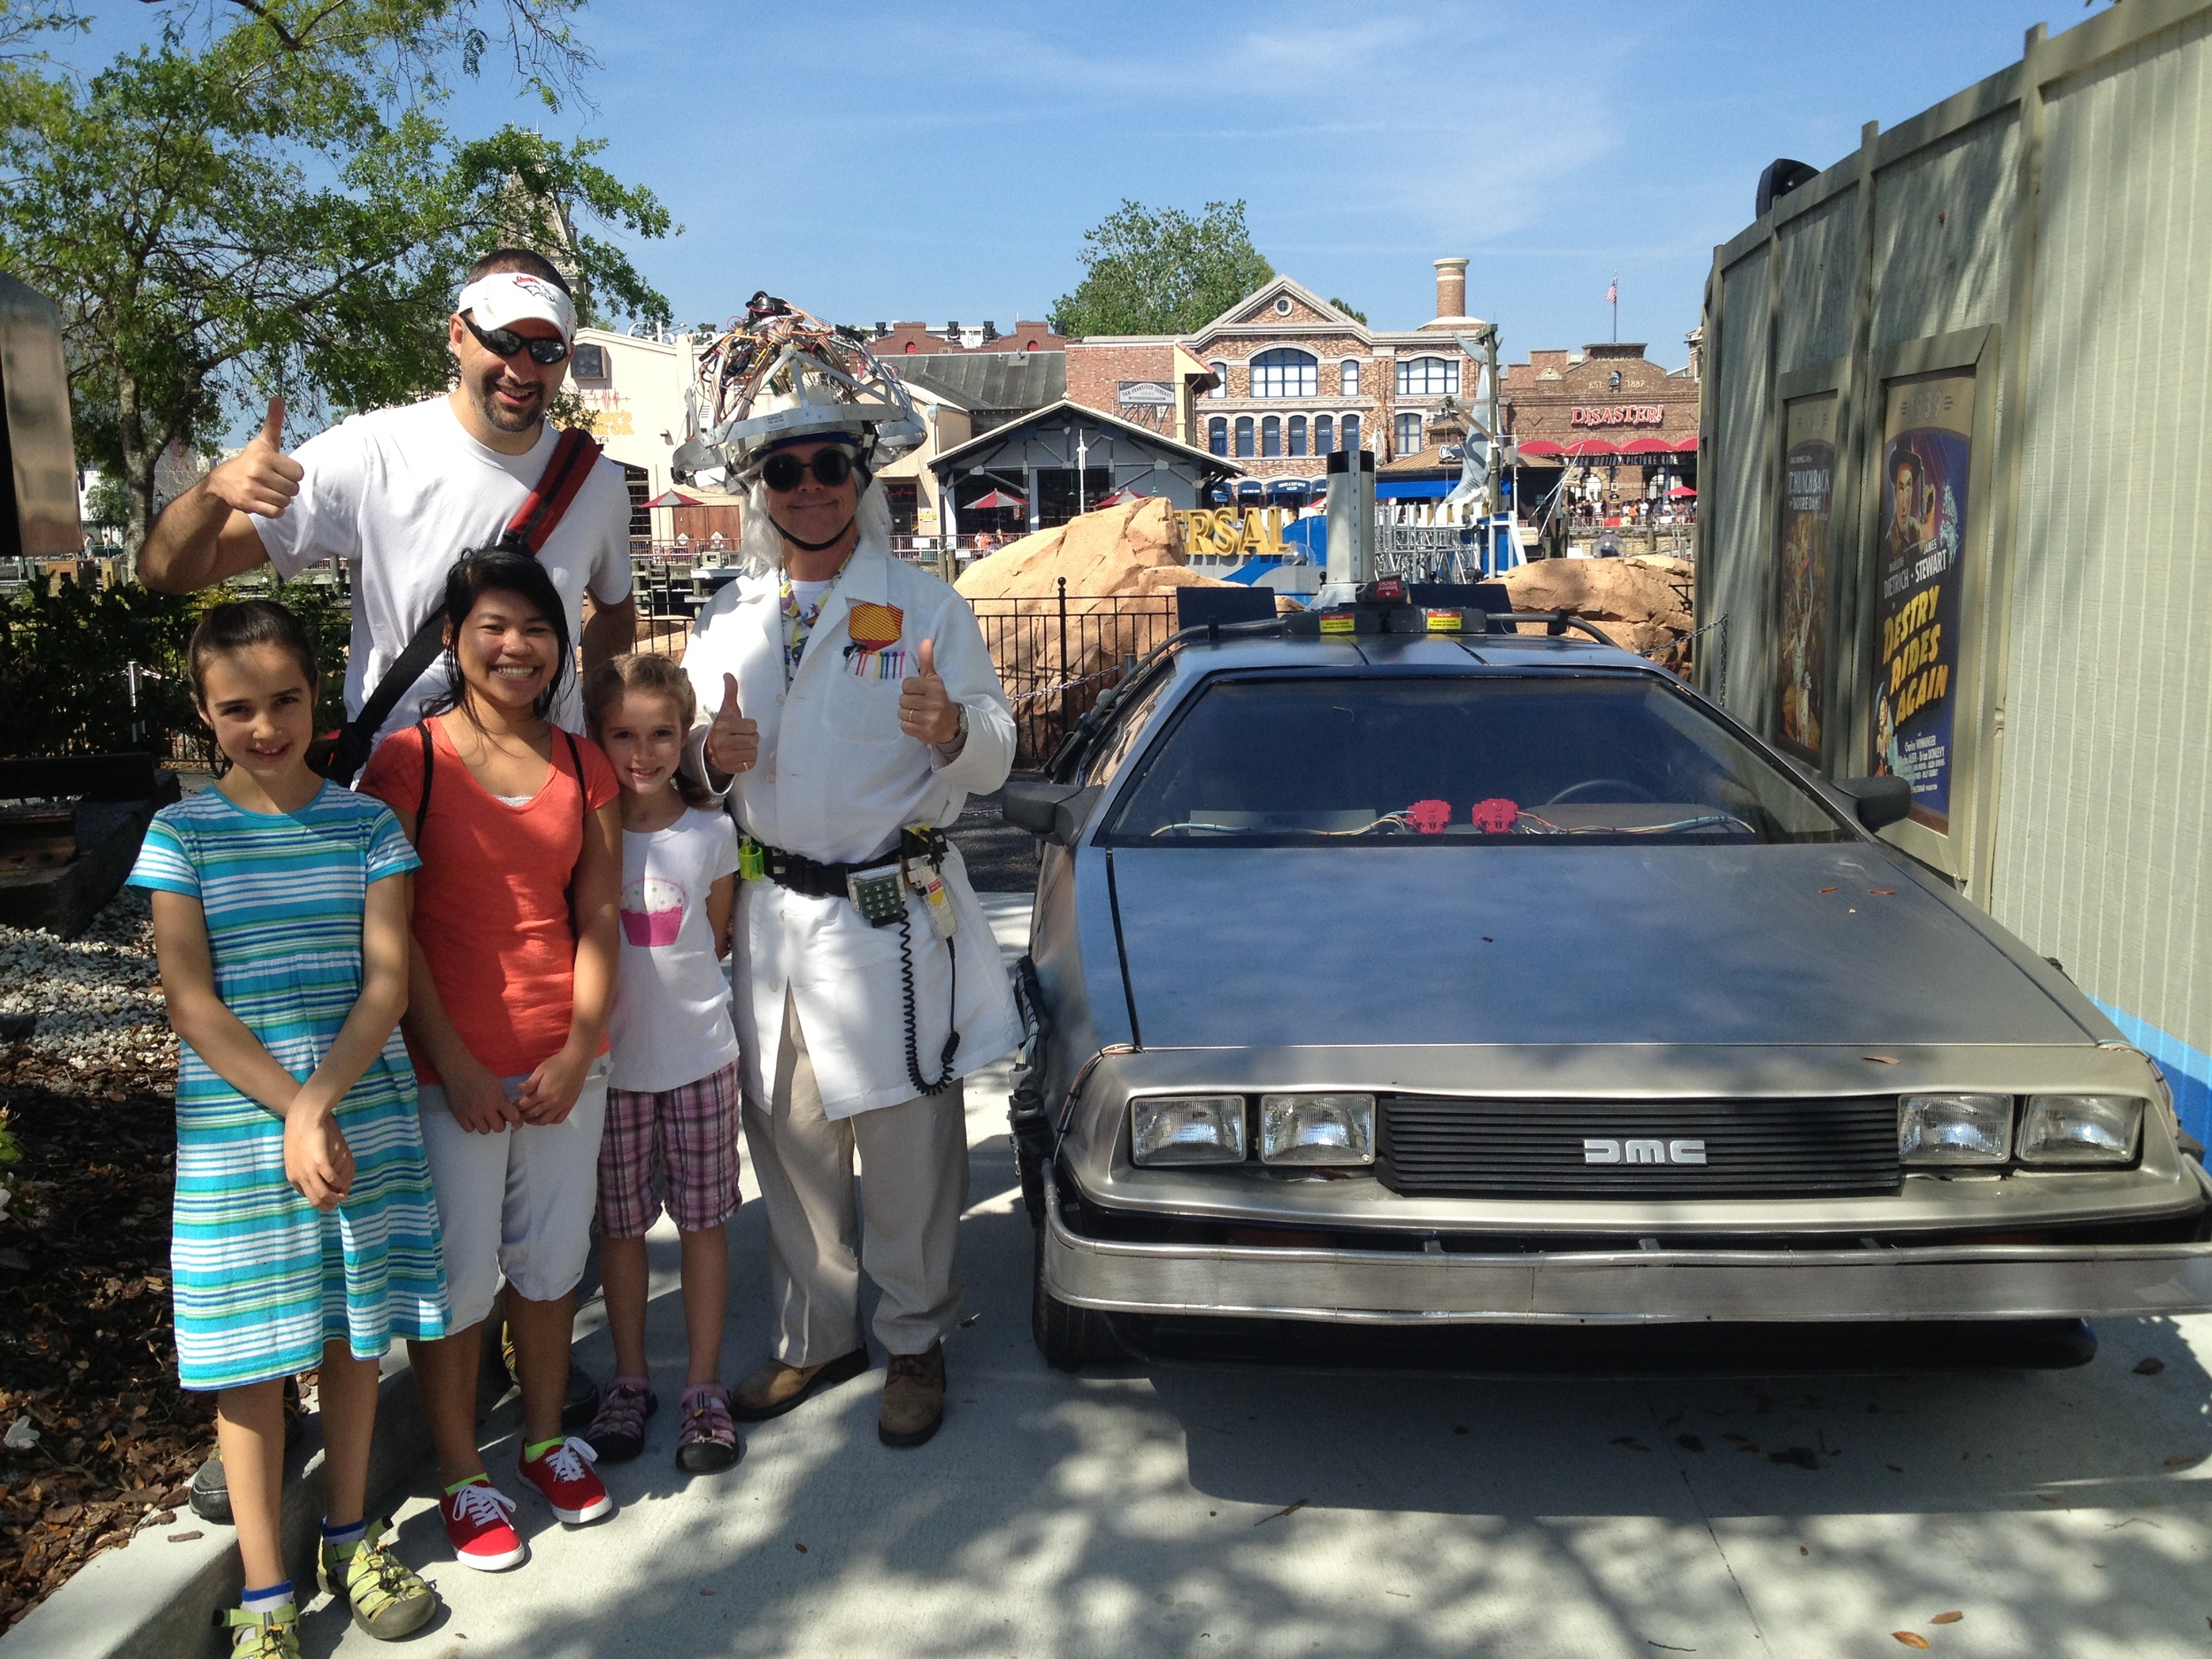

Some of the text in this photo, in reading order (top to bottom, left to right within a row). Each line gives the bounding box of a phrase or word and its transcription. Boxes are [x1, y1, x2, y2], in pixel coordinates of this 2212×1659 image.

[1132, 383, 1154, 393] FRANCISCO
[1571, 404, 1663, 426] DISASTER!
[1910, 390, 1942, 420] 1939
[1594, 456, 1622, 466] MOTION
[1626, 456, 1656, 465] PICTURE
[1662, 455, 1678, 465] RIDE
[1923, 538, 1937, 555] JAMES
[1884, 549, 1947, 600] DIETRICH STEWART
[1883, 585, 1940, 665] DESTRY
[1890, 623, 1940, 696] RIDES
[1894, 664, 1948, 726] AGAIN
[1584, 1140, 1707, 1164] DMC
